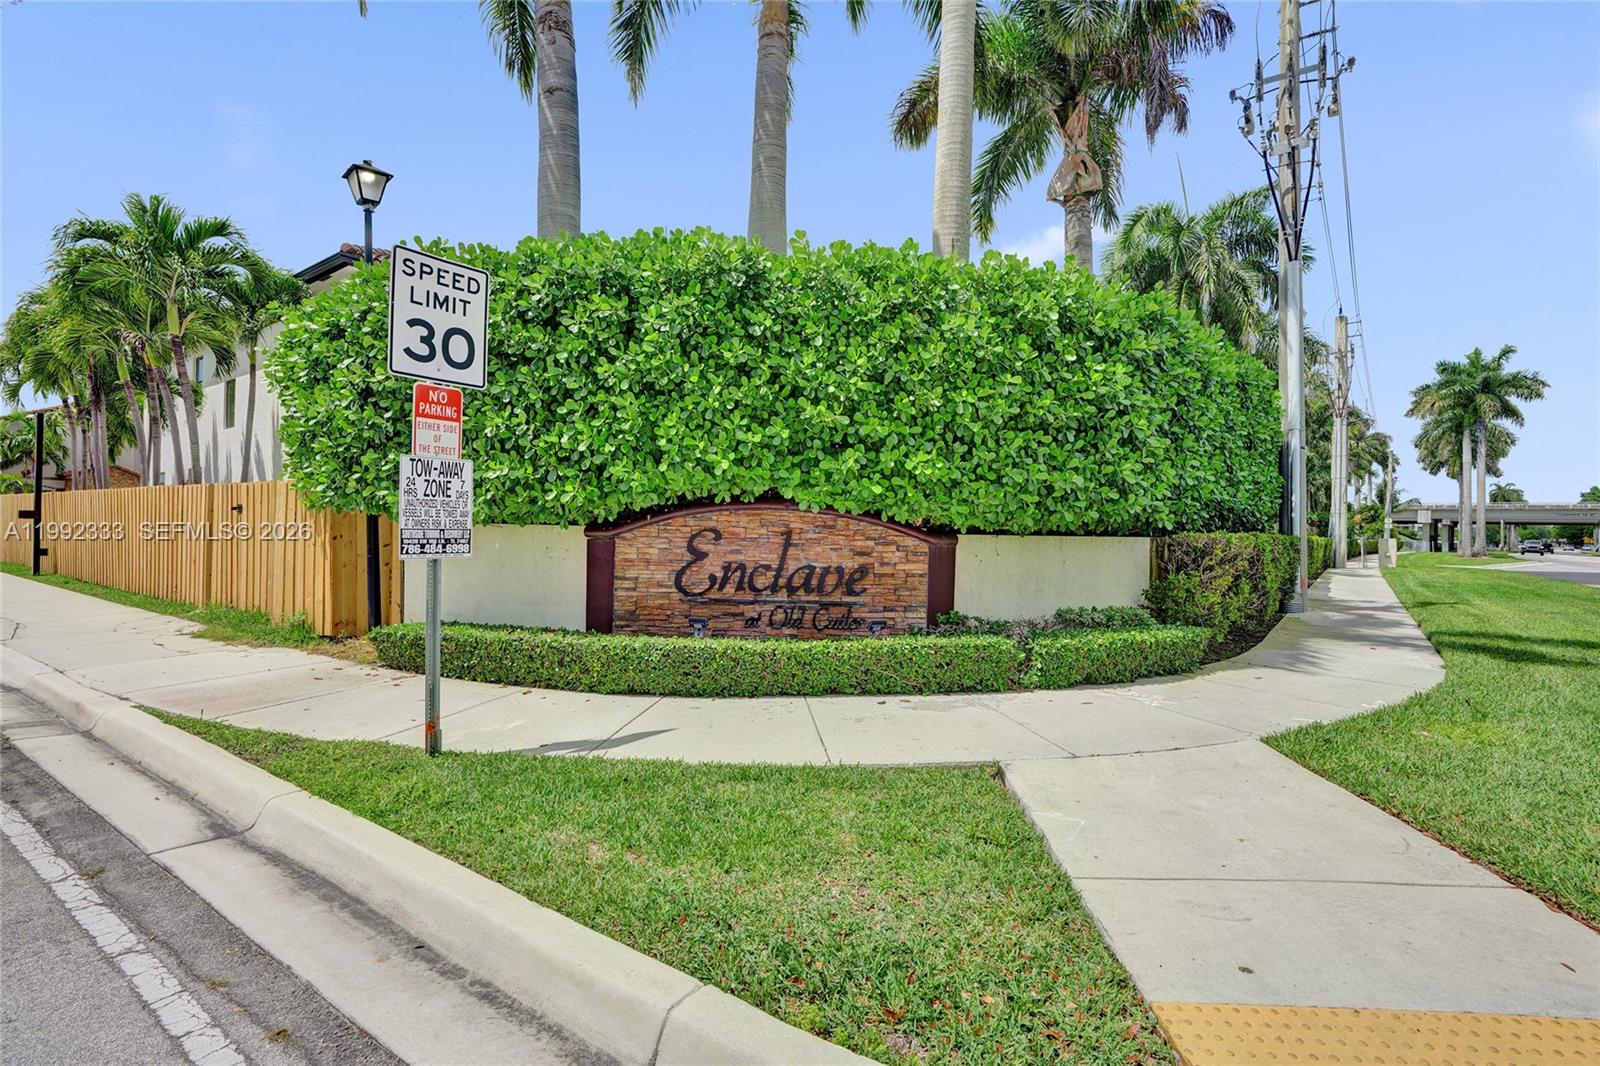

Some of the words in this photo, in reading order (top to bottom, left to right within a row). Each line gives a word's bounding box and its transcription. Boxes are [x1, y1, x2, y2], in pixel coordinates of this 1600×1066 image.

[402, 258, 481, 295] SPEED
[410, 285, 471, 317] LIMIT
[403, 318, 475, 370] 30
[429, 390, 448, 404] NO
[419, 402, 457, 419] PARKING
[417, 421, 440, 432] EITHER
[443, 424, 458, 434] SIDE
[433, 434, 442, 443] OF
[419, 444, 431, 454] THE
[433, 445, 456, 456] STREET
[410, 458, 465, 479] TOW-AWAY
[406, 477, 416, 487] 24
[423, 479, 452, 498] ZONE
[460, 481, 465, 489] 7
[403, 488, 418, 498] HRS
[455, 490, 469, 500] DAYS
[402, 544, 470, 554] 786-484-6998
[674, 528, 869, 597] Enclave
[744, 612, 762, 629] at
[769, 604, 806, 630] Old
